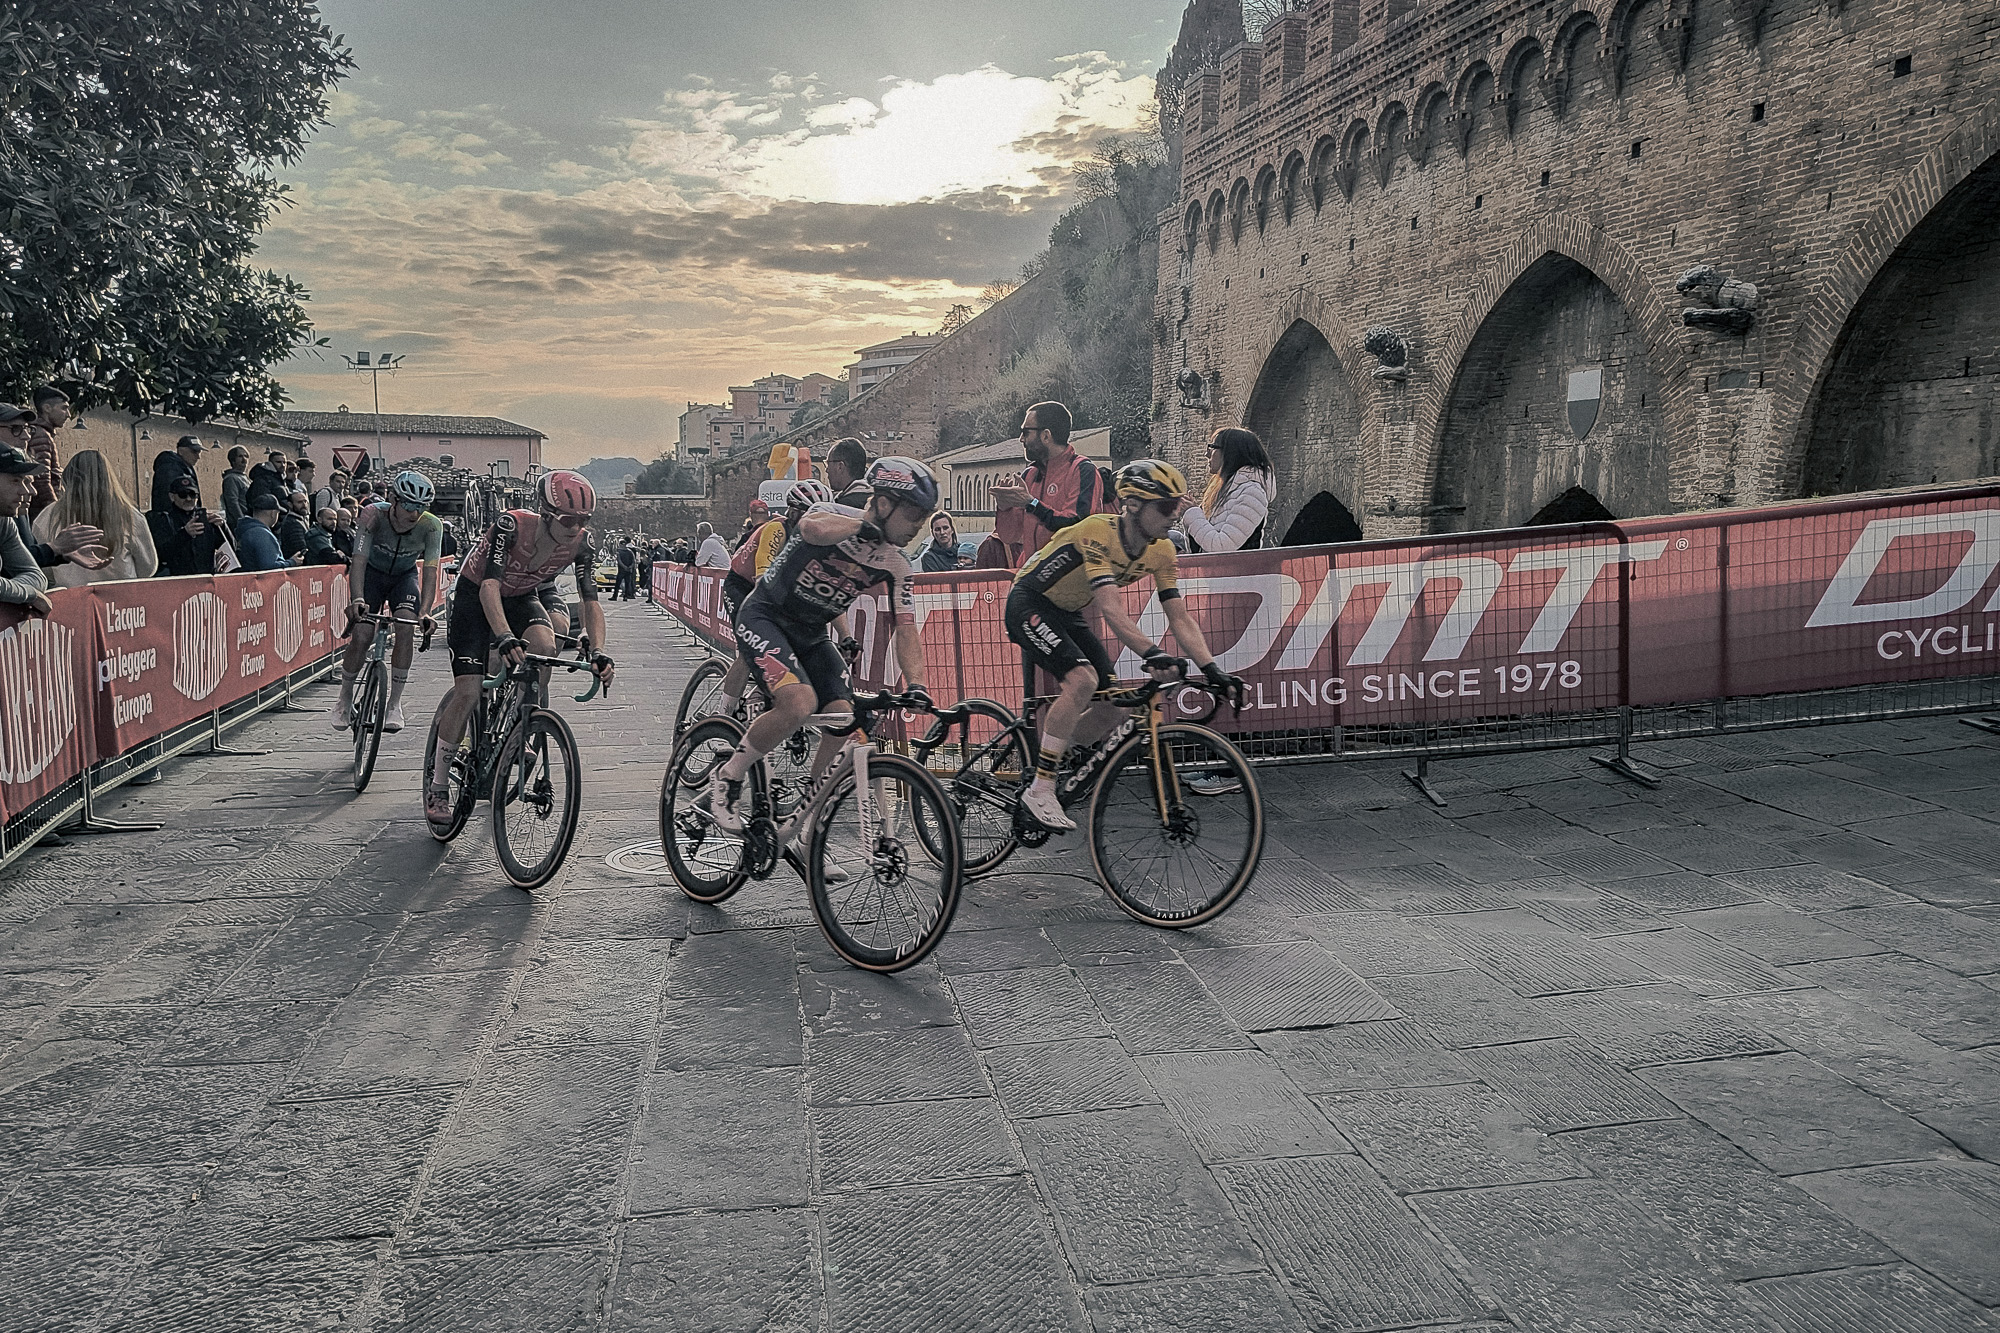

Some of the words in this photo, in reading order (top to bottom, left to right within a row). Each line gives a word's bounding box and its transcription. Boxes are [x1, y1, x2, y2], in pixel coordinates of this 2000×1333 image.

[1804, 509, 2000, 628] D
[106, 602, 146, 637] L'acqua
[737, 623, 770, 653] BORA
[1876, 622, 2000, 660] CYCLI
[117, 646, 157, 683] leggera
[1176, 677, 1347, 715] CCLING
[1361, 668, 1481, 703] SINCE
[1494, 660, 1582, 694] 1978
